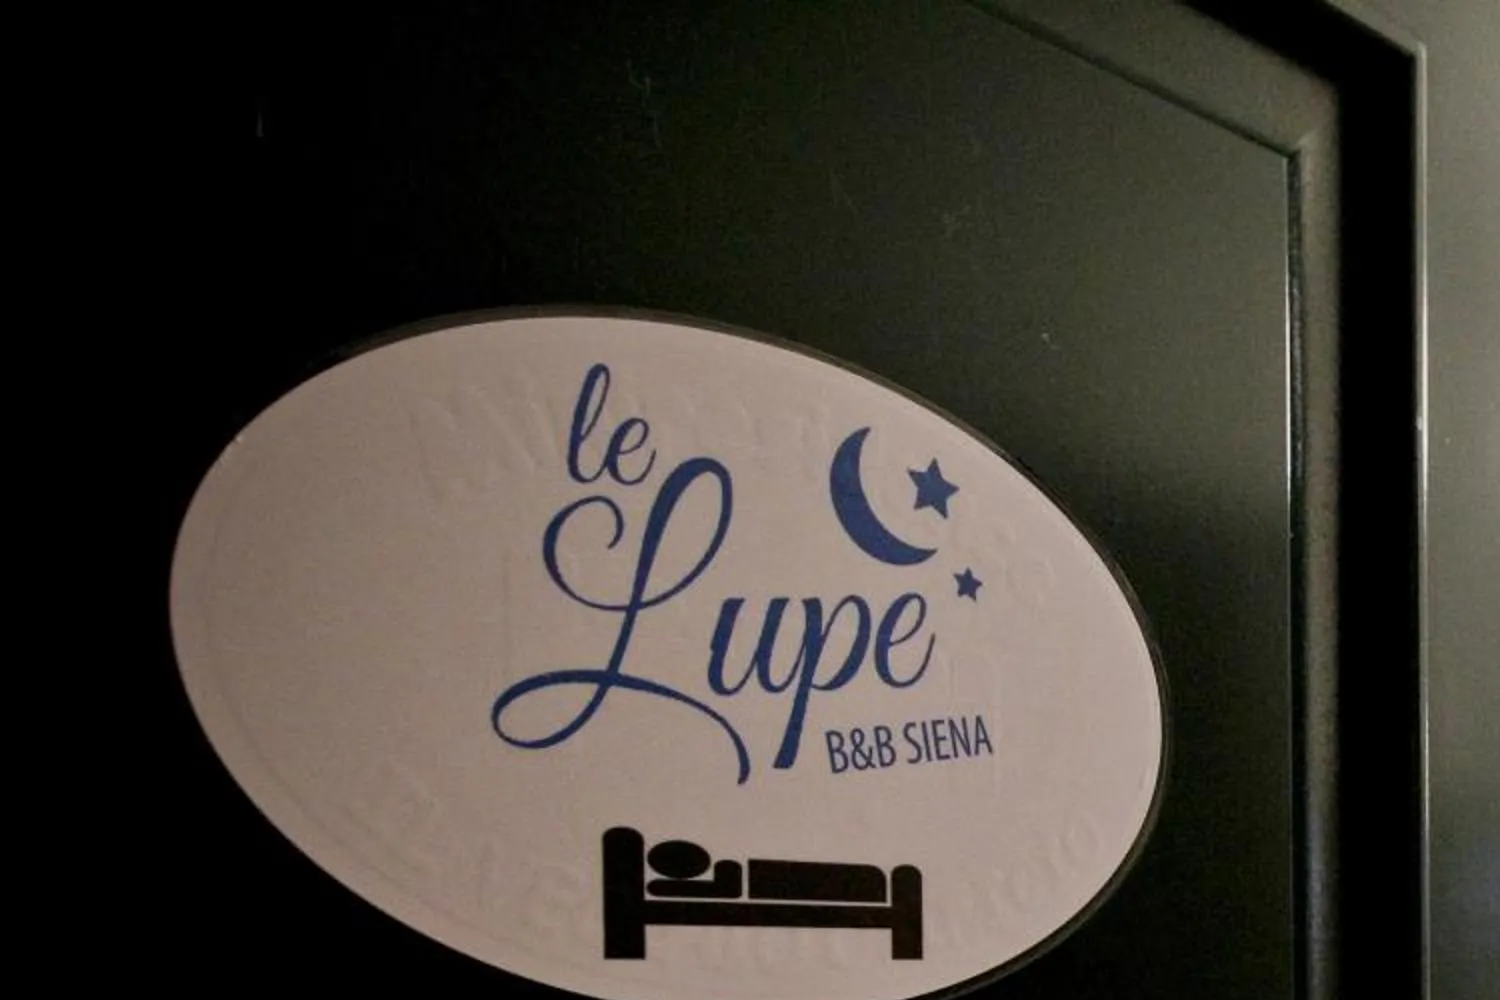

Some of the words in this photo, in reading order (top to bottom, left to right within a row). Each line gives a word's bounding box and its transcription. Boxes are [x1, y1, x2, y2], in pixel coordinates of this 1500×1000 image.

[566, 362, 657, 487] le
[490, 455, 937, 786] Lupe
[824, 725, 898, 775] B&B
[902, 714, 994, 765] SIENA
